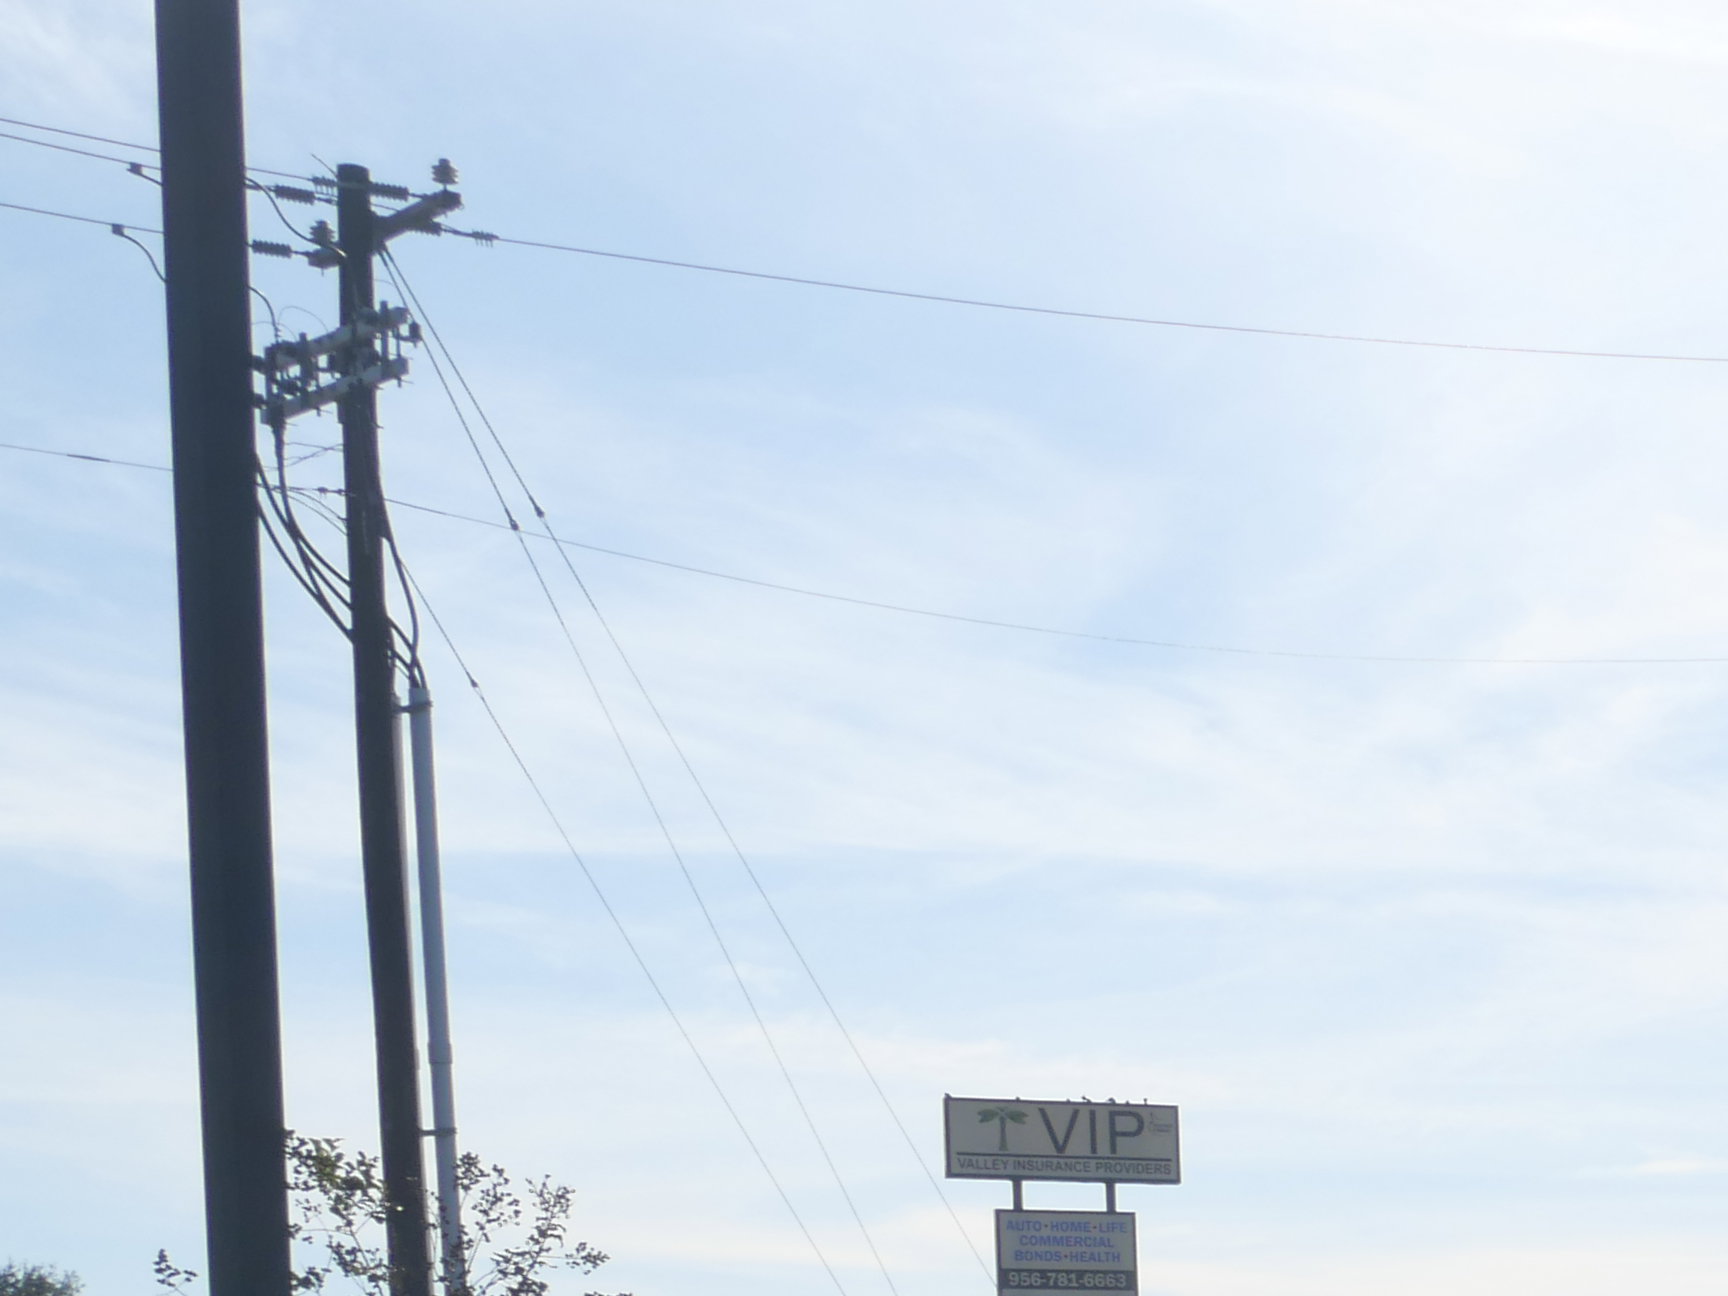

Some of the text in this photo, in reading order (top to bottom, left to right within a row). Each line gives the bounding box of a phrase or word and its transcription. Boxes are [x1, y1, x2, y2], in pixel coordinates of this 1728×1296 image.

[1038, 1107, 1145, 1155] VIP
[957, 1157, 1172, 1175] VALLEY INSURANCE PROVIDERS
[1006, 1220, 1128, 1233] AUTO HOME LIFE
[1019, 1235, 1114, 1248] COMMERCIAL
[1014, 1250, 1121, 1263] BONDS HEALTH
[1008, 1272, 1127, 1288] 956-781-6663
